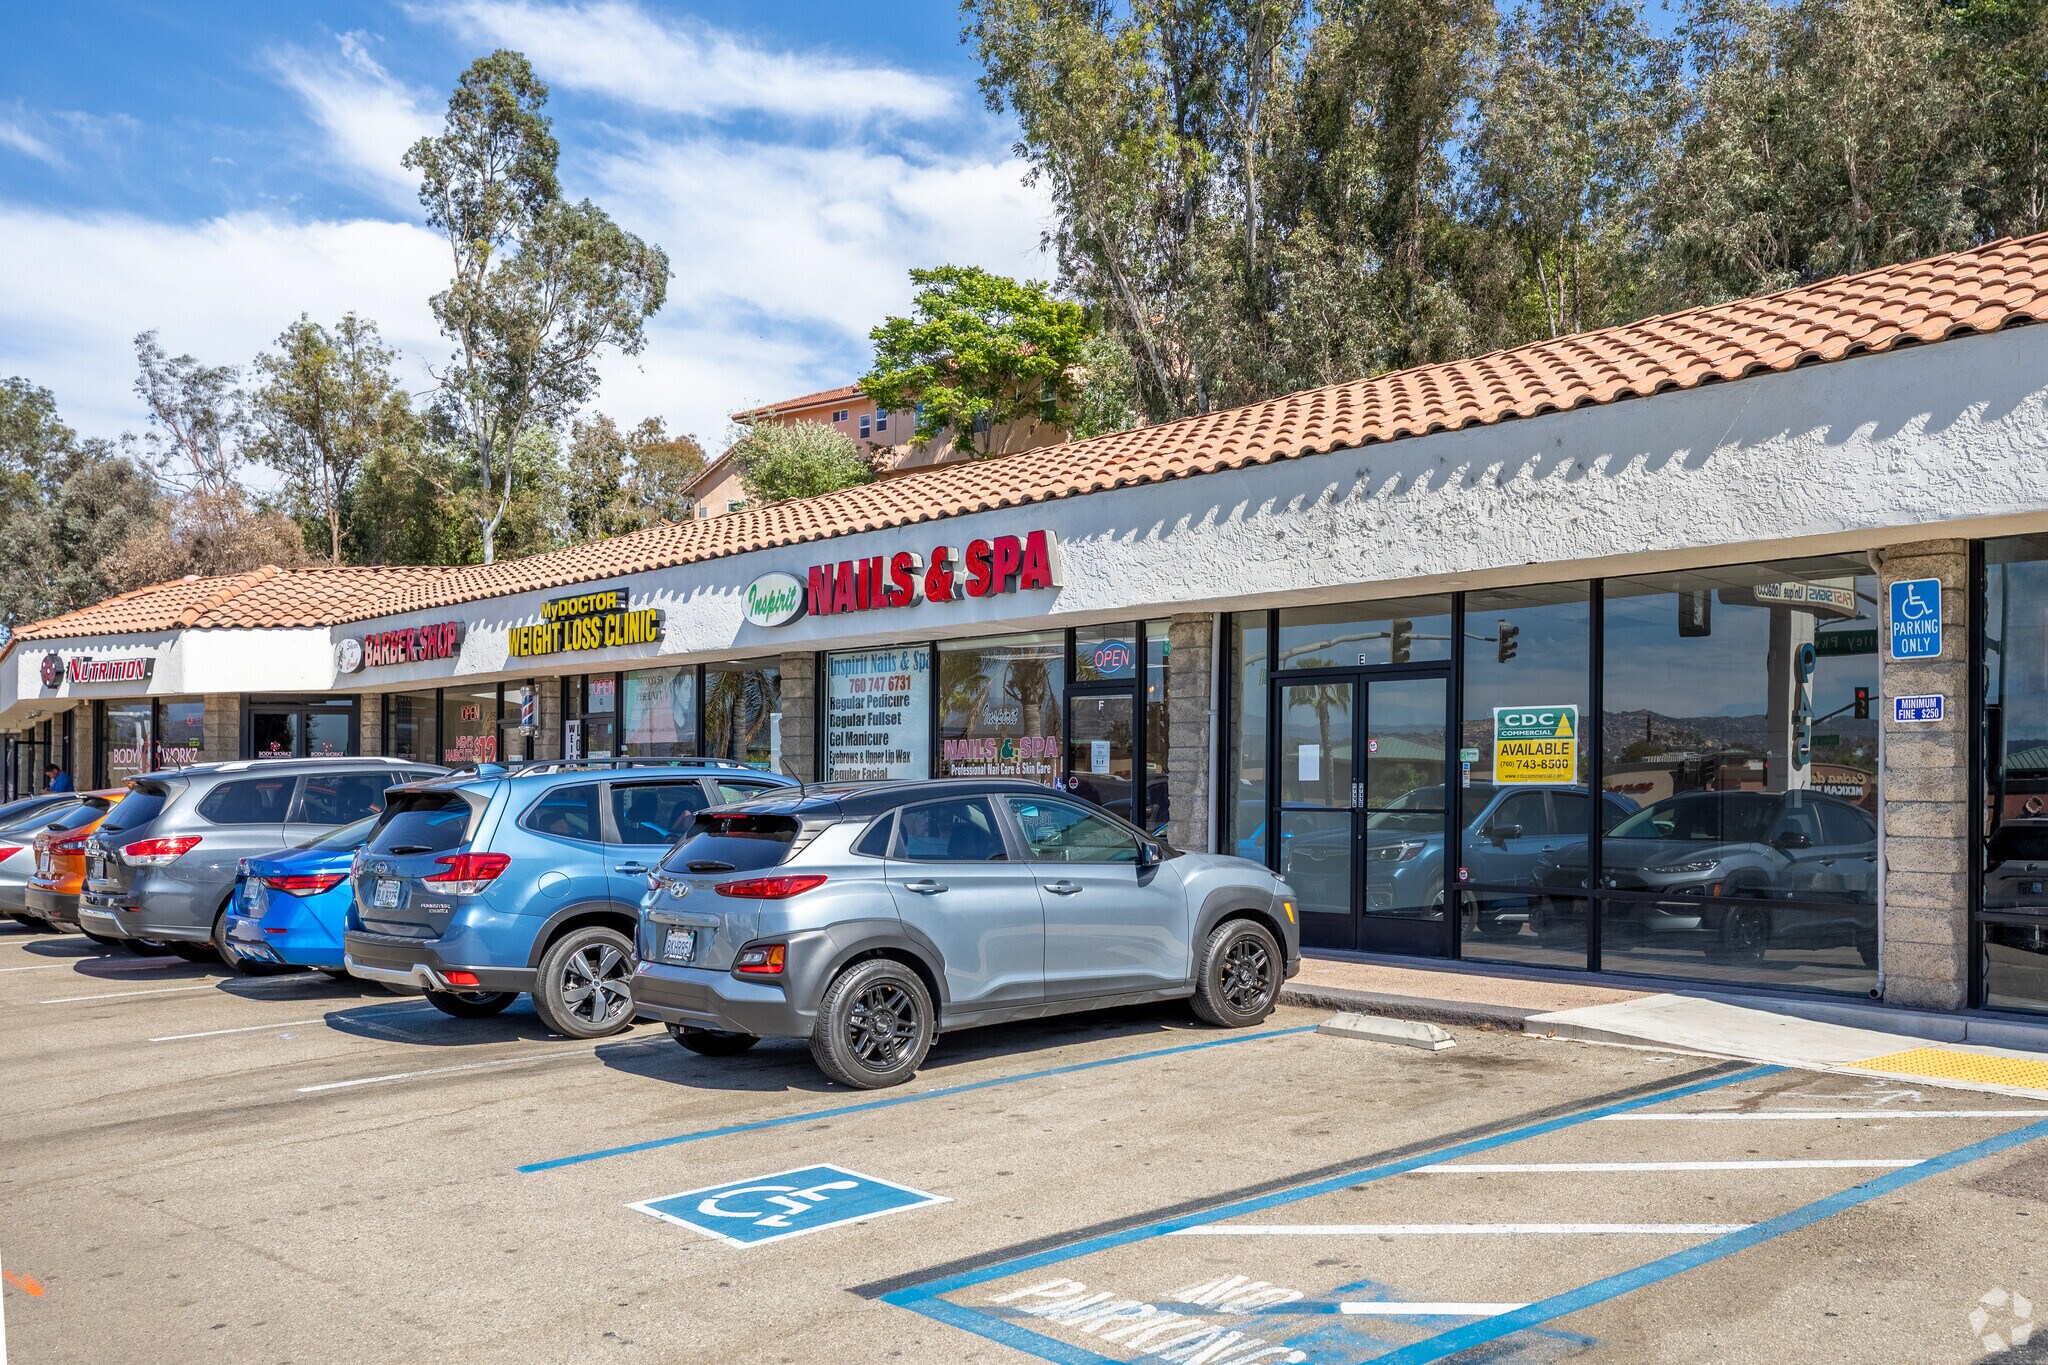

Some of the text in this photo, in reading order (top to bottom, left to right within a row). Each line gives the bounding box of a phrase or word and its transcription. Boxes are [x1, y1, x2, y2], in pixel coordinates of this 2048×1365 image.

[750, 530, 1053, 622] Inspirit NAILS & SPA
[509, 608, 657, 657] WEIGHT LOSS CLINIC
[1893, 619, 1938, 636] PARKING
[365, 621, 457, 667] BARBER SHOP
[1901, 637, 1930, 653] ONLY
[830, 654, 868, 678] Inspirit
[871, 653, 896, 673] Nails
[900, 651, 909, 671] &
[1095, 650, 1129, 667] OPEN
[1359, 654, 1364, 664] E
[593, 679, 615, 695] OPEN
[849, 675, 911, 693] 760 747 6731
[830, 694, 910, 711] Regular Pedicure
[1098, 701, 1104, 710] F
[1901, 698, 1937, 709] MINIMUM
[462, 704, 480, 720] OPEN
[830, 712, 901, 728] Regular Fullset
[982, 702, 1018, 730] Inspirit
[1504, 713, 1554, 726] CDC
[1898, 708, 1939, 719] FINE $250
[830, 731, 889, 746] Gel Manicure
[113, 747, 198, 763] BODY WORKZ
[445, 749, 474, 762] HAIRCUTS
[474, 735, 497, 763] $12
[944, 736, 1058, 760] NAILS & SPA
[1501, 742, 1570, 755] AVAILABLE
[830, 749, 911, 765] Eyebrows & Upper Lip Wax
[1516, 759, 1569, 769] 743-8500
[830, 767, 888, 780] Regular Facial
[951, 762, 1051, 776] Professional Nail Care & Skin Care
[1154, 1275, 1304, 1315] NO
